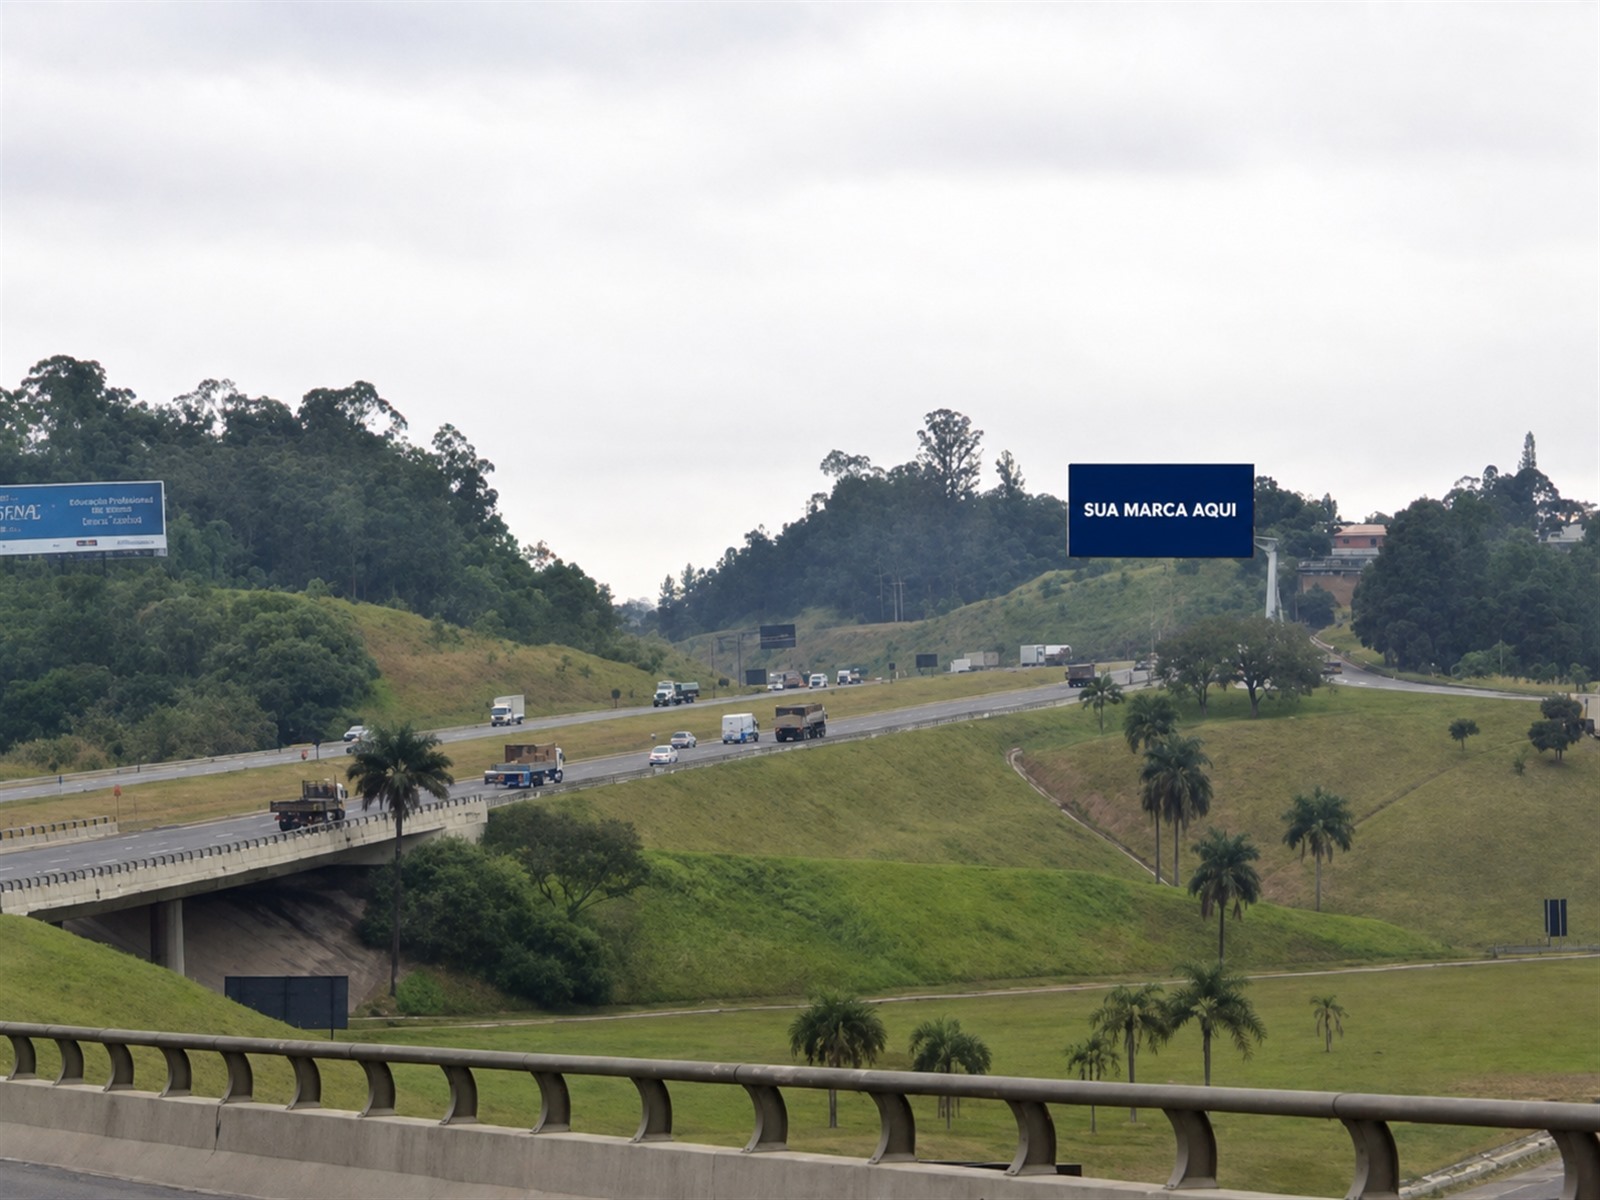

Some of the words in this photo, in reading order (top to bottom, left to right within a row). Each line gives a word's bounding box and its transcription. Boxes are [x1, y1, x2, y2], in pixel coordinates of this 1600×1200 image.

[1084, 502, 1119, 517] SUA
[1124, 502, 1188, 517] MARCA
[1192, 502, 1237, 518] AQUI
